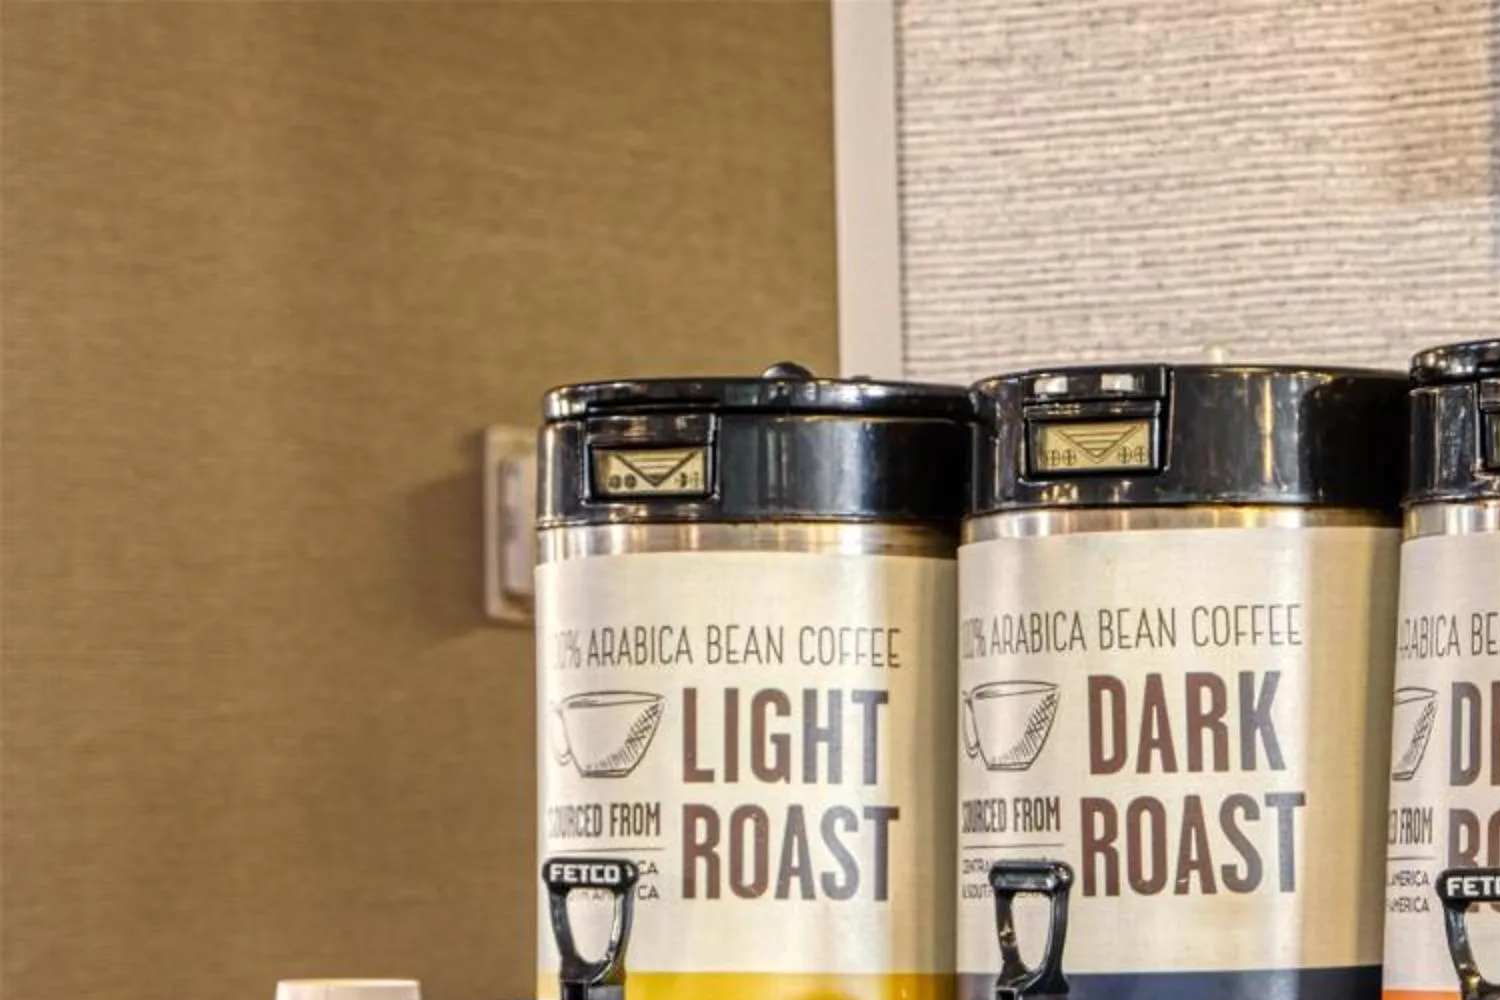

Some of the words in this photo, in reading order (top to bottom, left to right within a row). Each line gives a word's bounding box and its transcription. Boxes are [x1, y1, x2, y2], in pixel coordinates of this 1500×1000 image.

[586, 624, 694, 669] ARABICA
[705, 623, 785, 666] BEAN
[798, 625, 902, 668] COFFEE
[990, 609, 1088, 656] ARABICA
[1096, 607, 1177, 652] BEAN
[1191, 604, 1303, 647] COFFEE
[681, 686, 890, 786] LIGHT
[1086, 670, 1286, 776] DARK
[608, 801, 662, 838] FROM
[1012, 795, 1062, 833] FROM
[681, 803, 900, 901] ROAST
[1080, 792, 1306, 897] ROAST
[549, 863, 621, 883] FETCO
